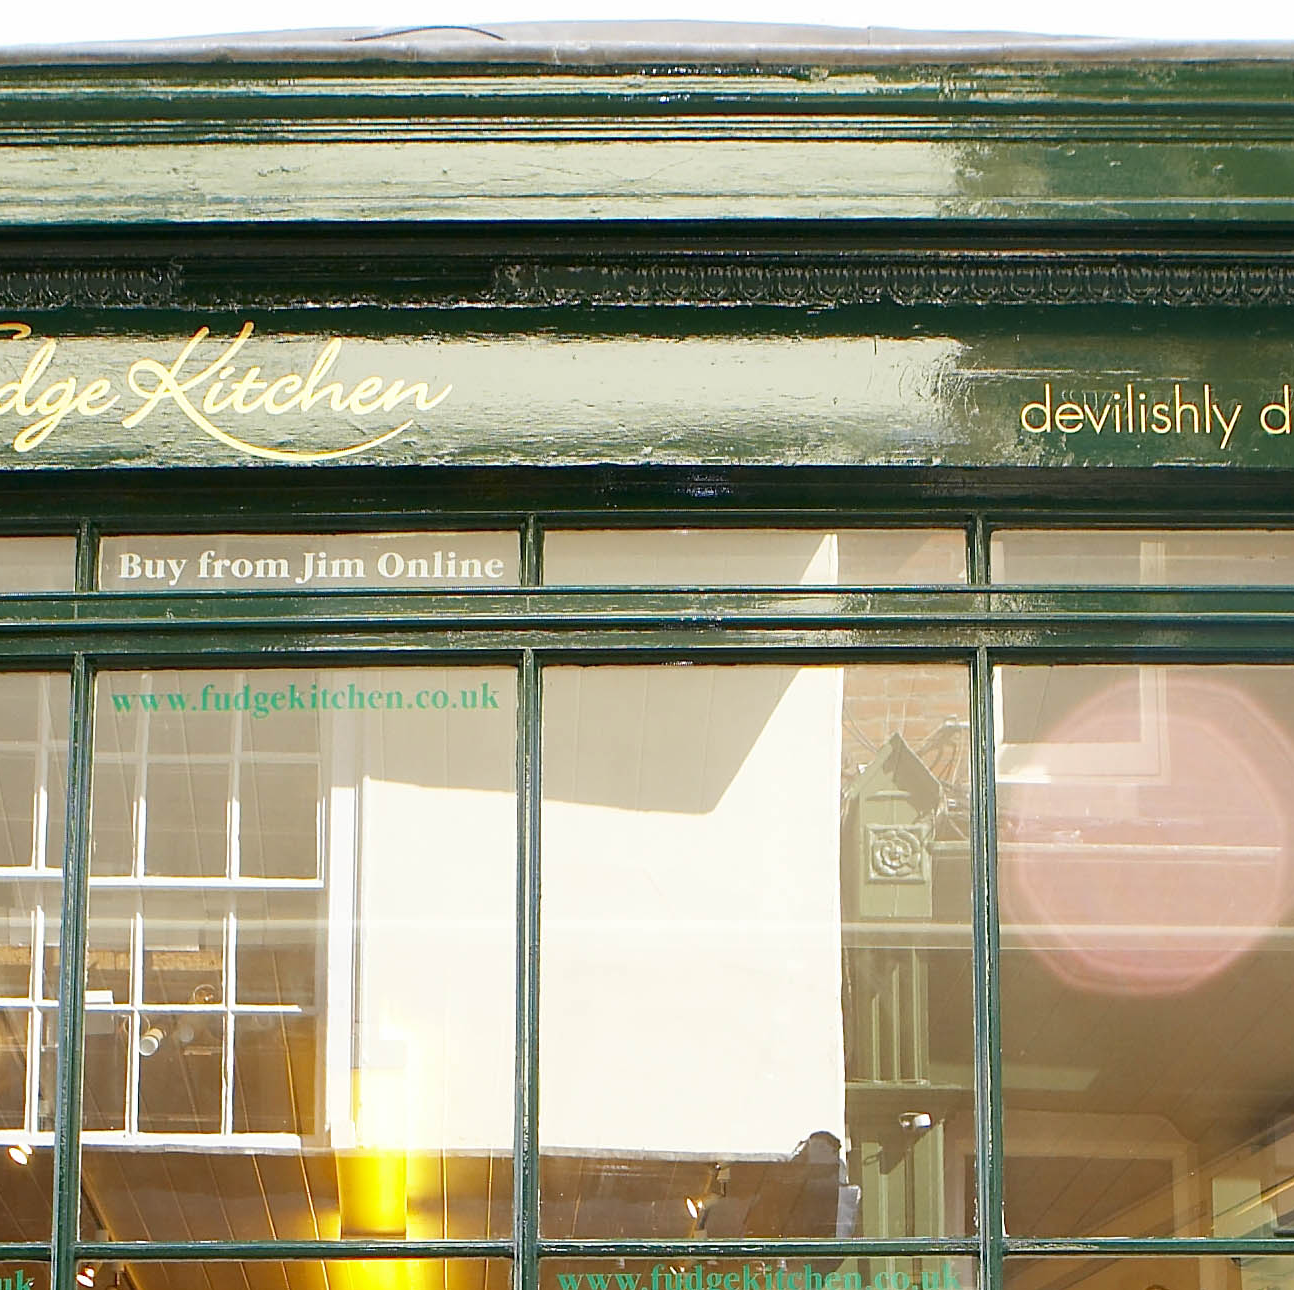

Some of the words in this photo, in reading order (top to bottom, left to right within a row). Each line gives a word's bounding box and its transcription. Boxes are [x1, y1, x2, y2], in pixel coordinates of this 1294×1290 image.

[120, 320, 454, 461] Kitchen
[1020, 382, 1243, 450] devilishly
[119, 552, 187, 586] Buy
[197, 550, 290, 578] from
[295, 551, 367, 584] Jim
[377, 550, 505, 579] Online
[111, 682, 500, 719] www.fudgekitchen.co.uk
